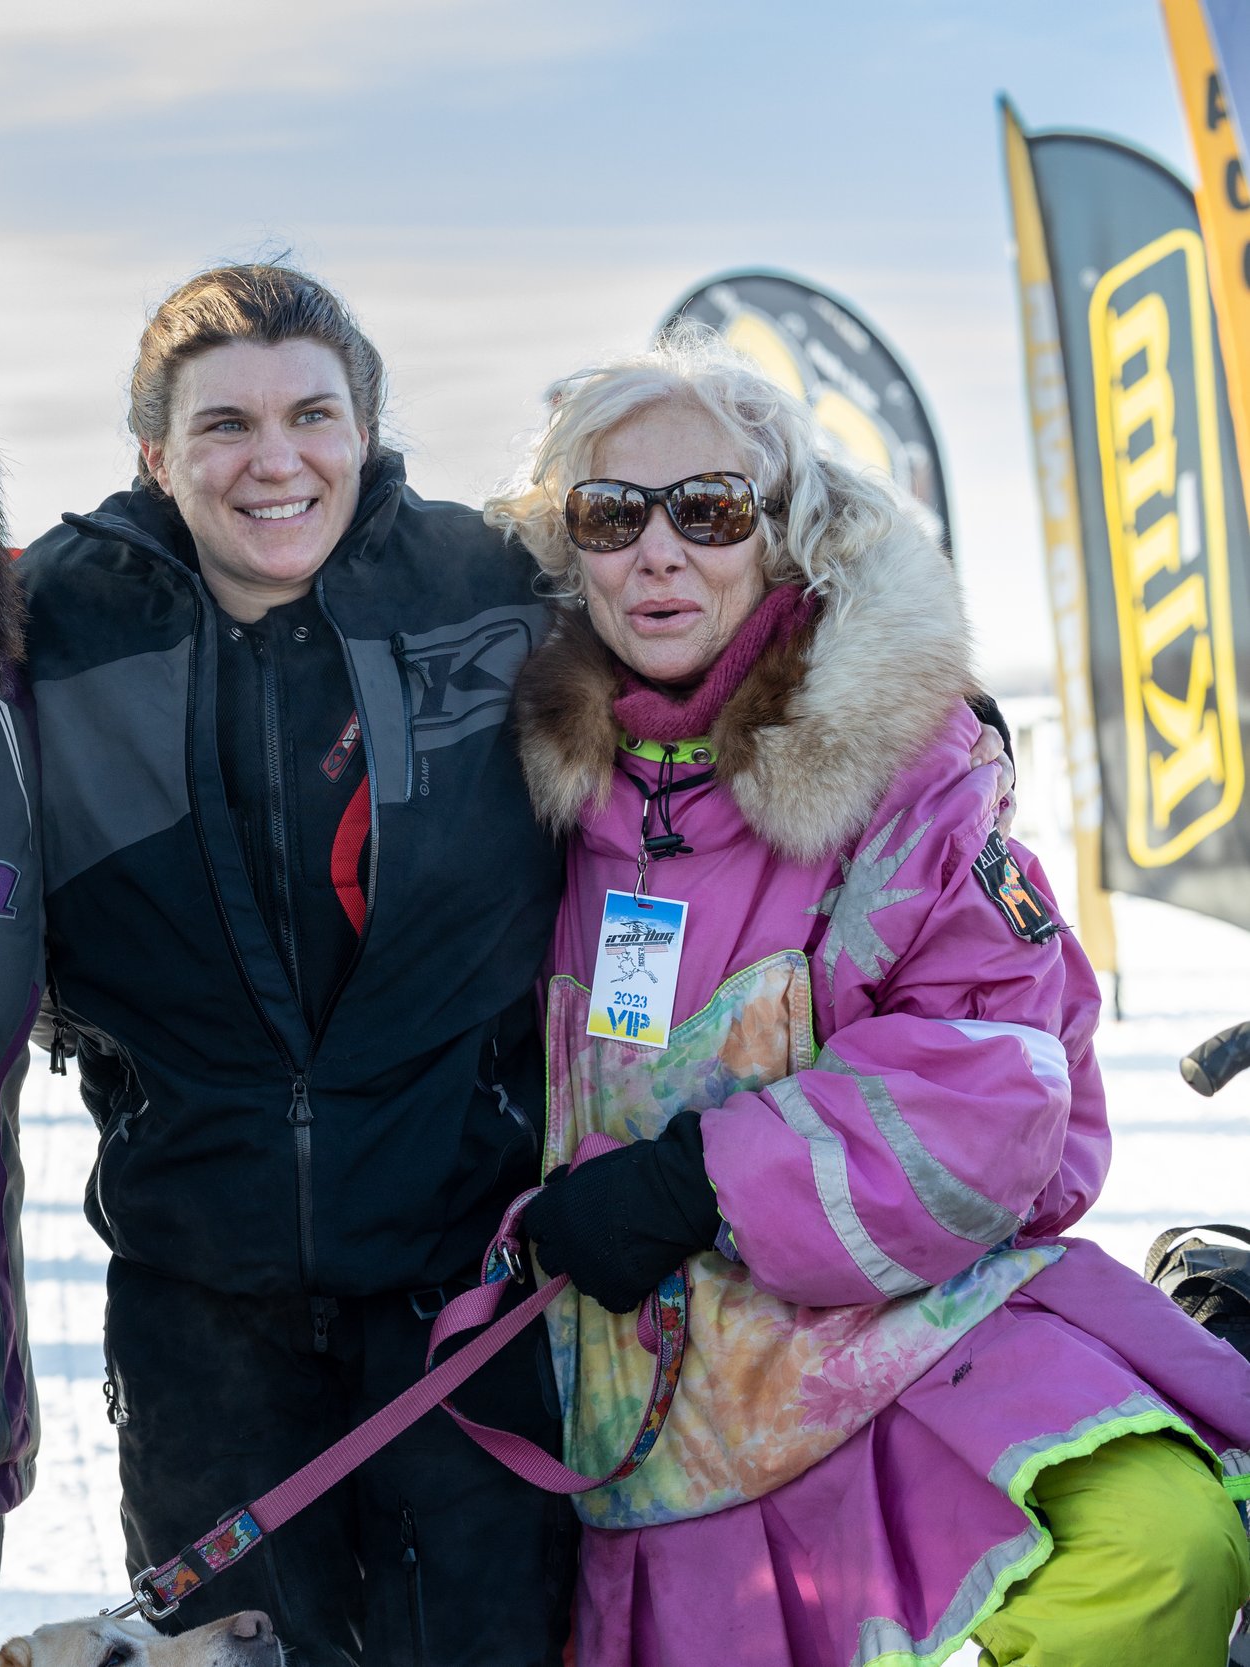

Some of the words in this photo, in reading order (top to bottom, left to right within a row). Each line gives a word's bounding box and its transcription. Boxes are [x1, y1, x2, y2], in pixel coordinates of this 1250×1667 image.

[422, 757, 431, 784] AMP
[614, 991, 648, 1009] 2023
[607, 1006, 650, 1038] VIP
